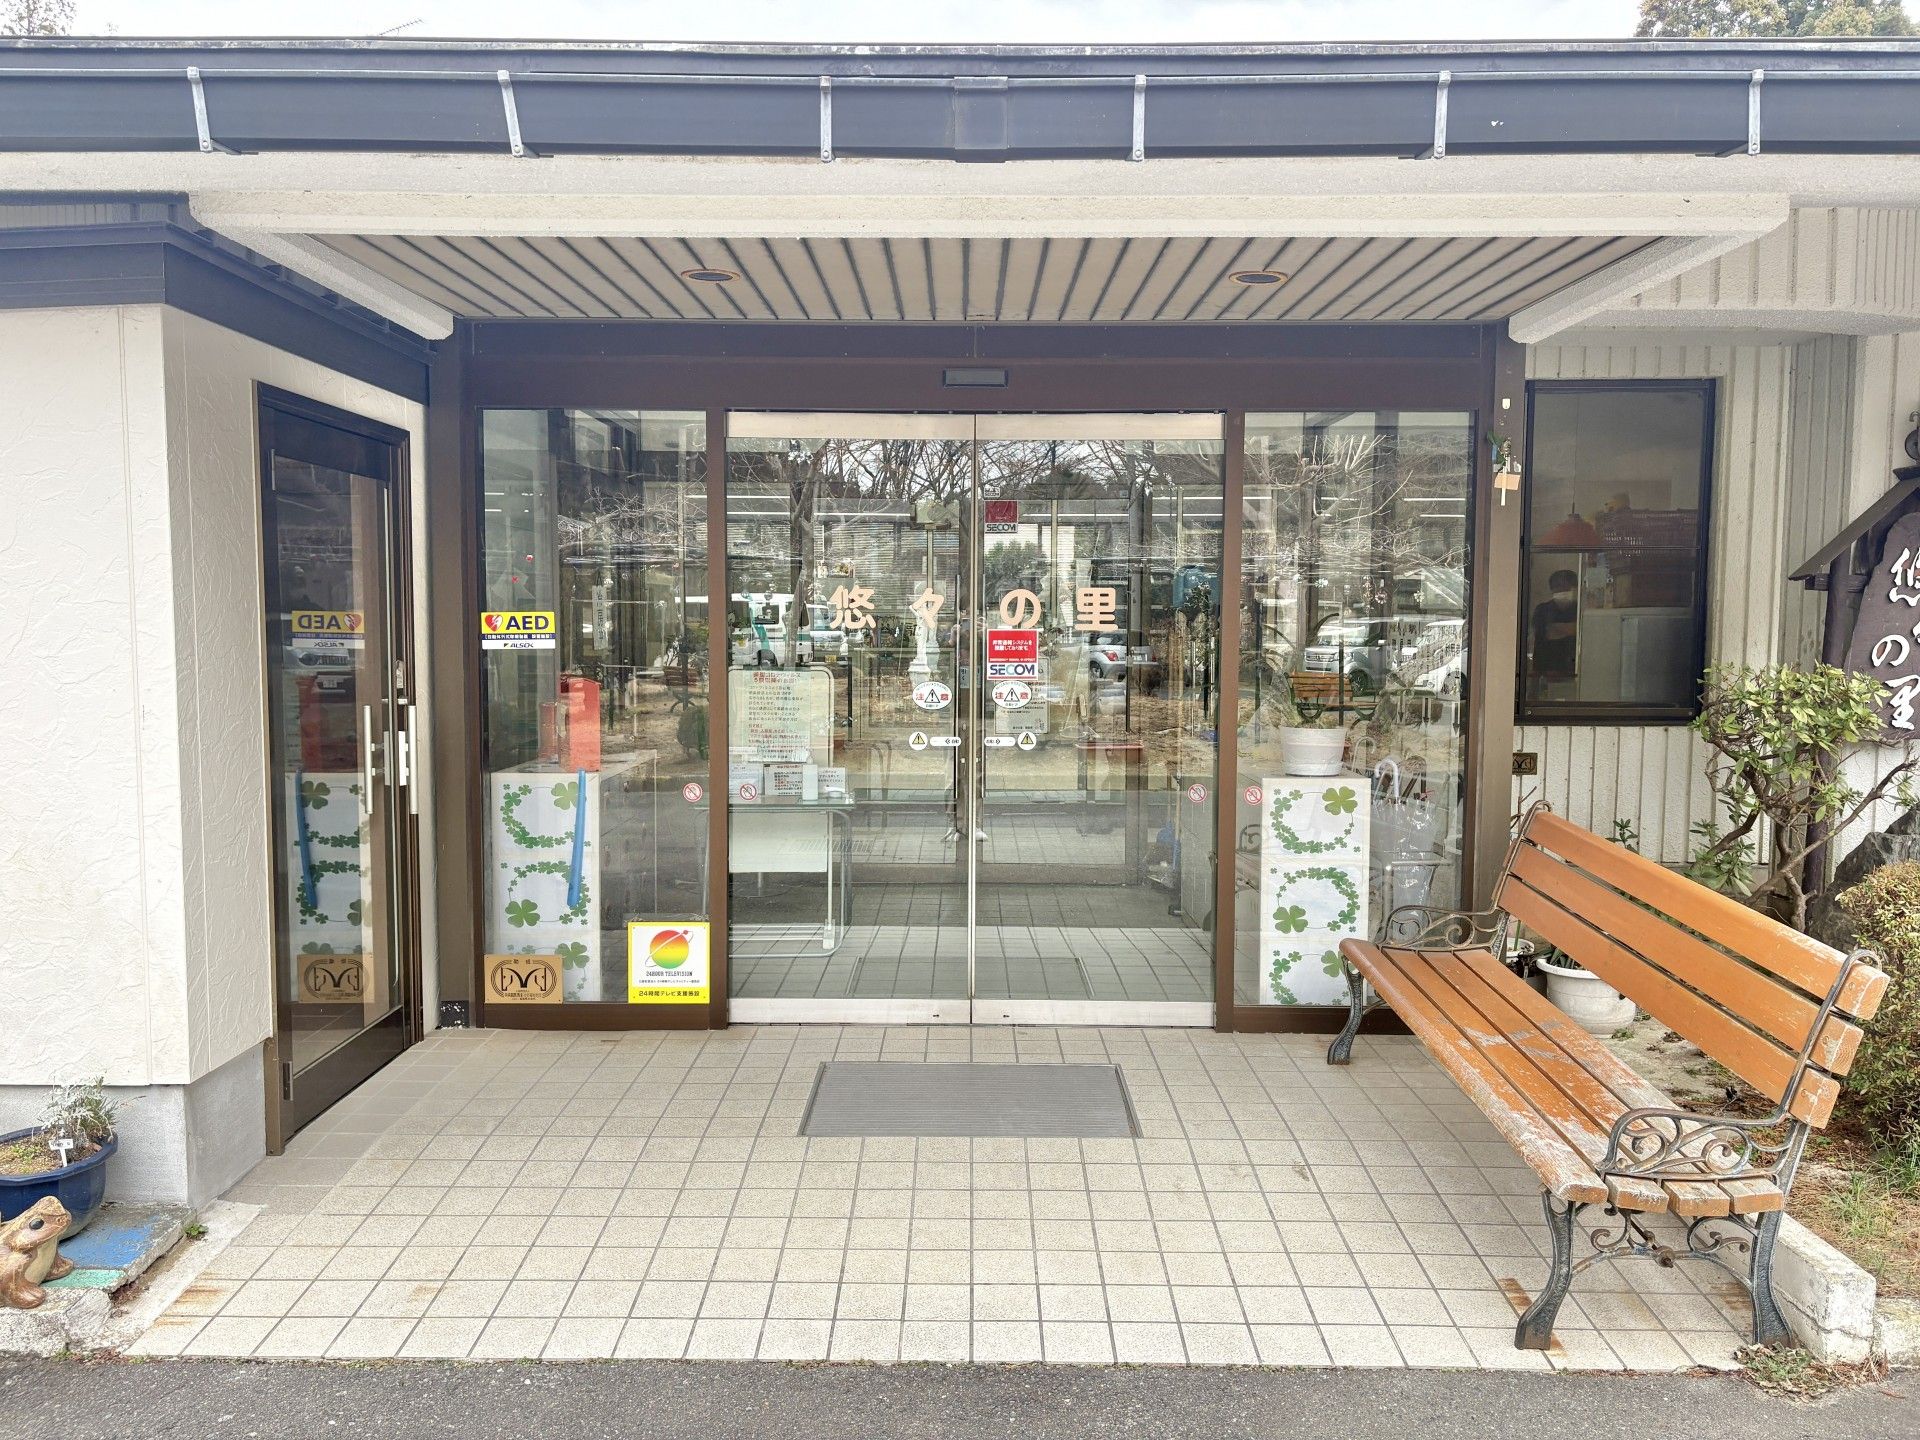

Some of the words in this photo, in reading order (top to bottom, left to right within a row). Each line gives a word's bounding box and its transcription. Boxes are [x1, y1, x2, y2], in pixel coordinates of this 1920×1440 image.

[986, 523, 1016, 532] SECOM
[505, 615, 550, 631] AED
[989, 663, 1035, 676] SECOM
